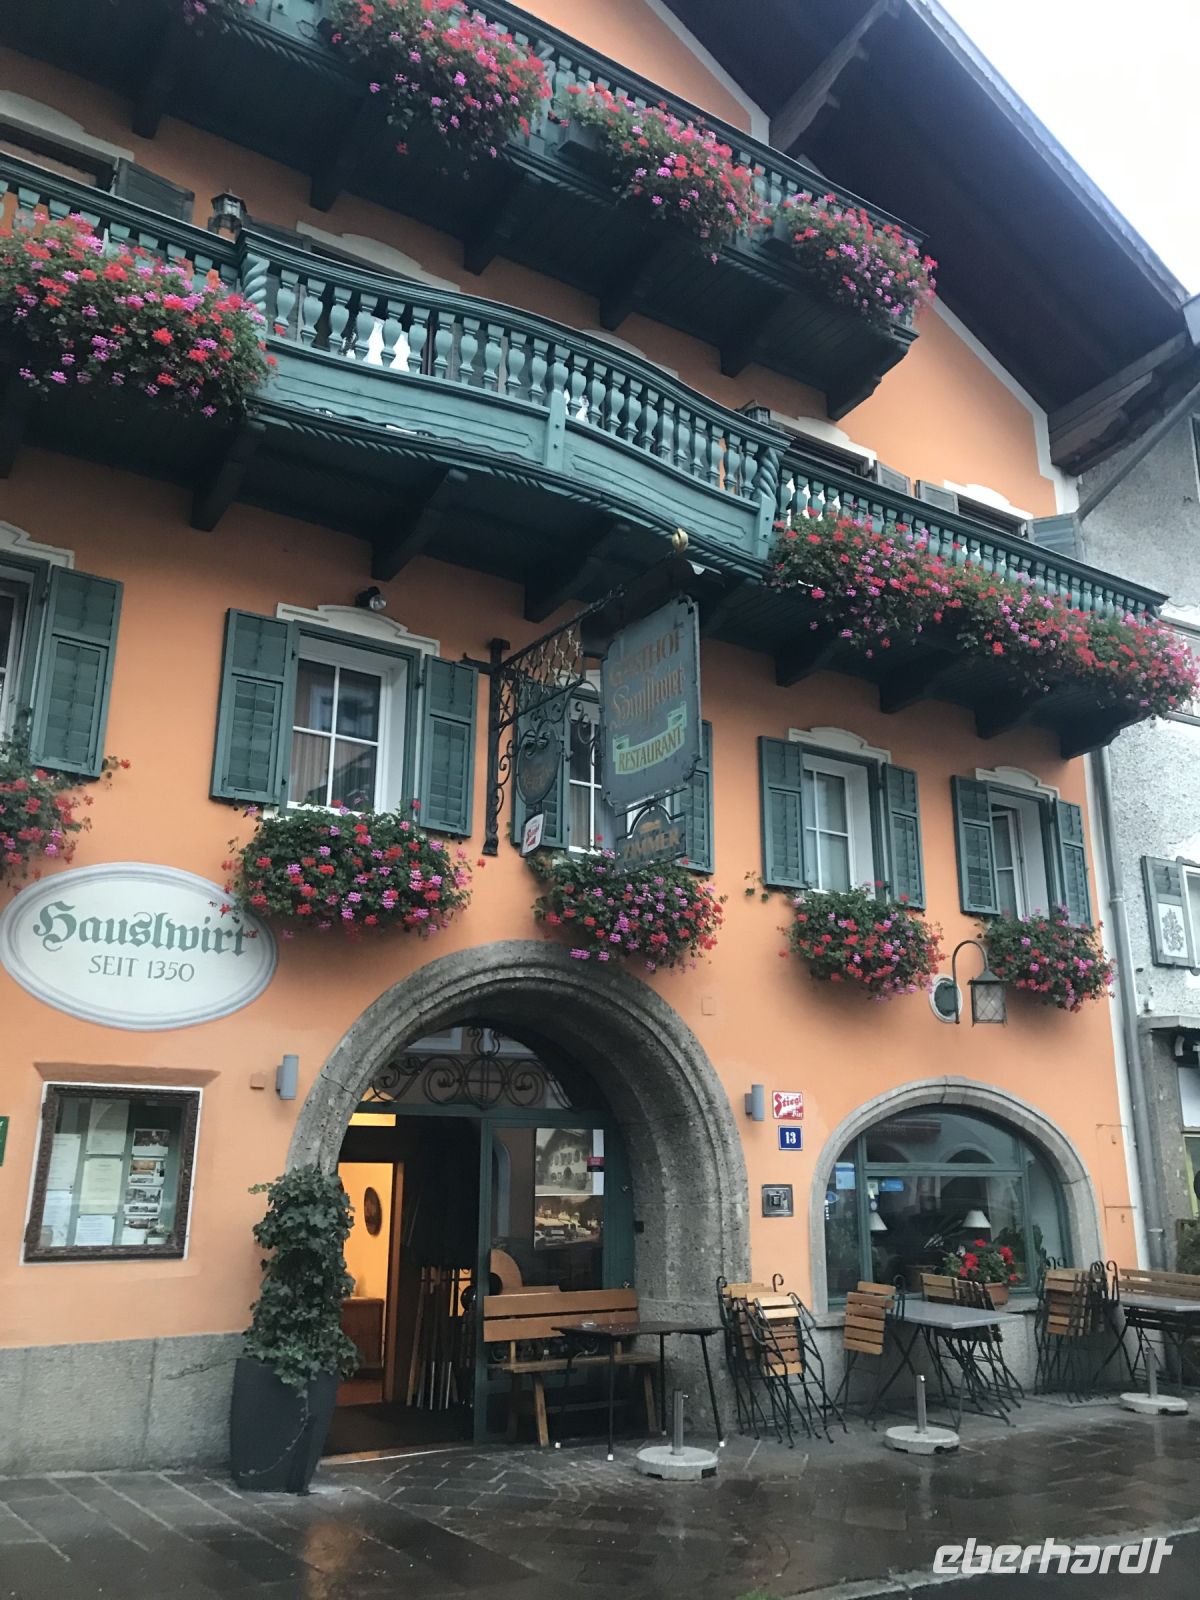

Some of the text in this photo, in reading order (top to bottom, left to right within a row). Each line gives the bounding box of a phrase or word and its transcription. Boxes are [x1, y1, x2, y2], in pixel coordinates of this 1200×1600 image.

[618, 726, 681, 771] RESTAURANT
[32, 901, 247, 956] Hauslwirt
[88, 955, 195, 982] SEIT 1350
[785, 1131, 797, 1144] 13
